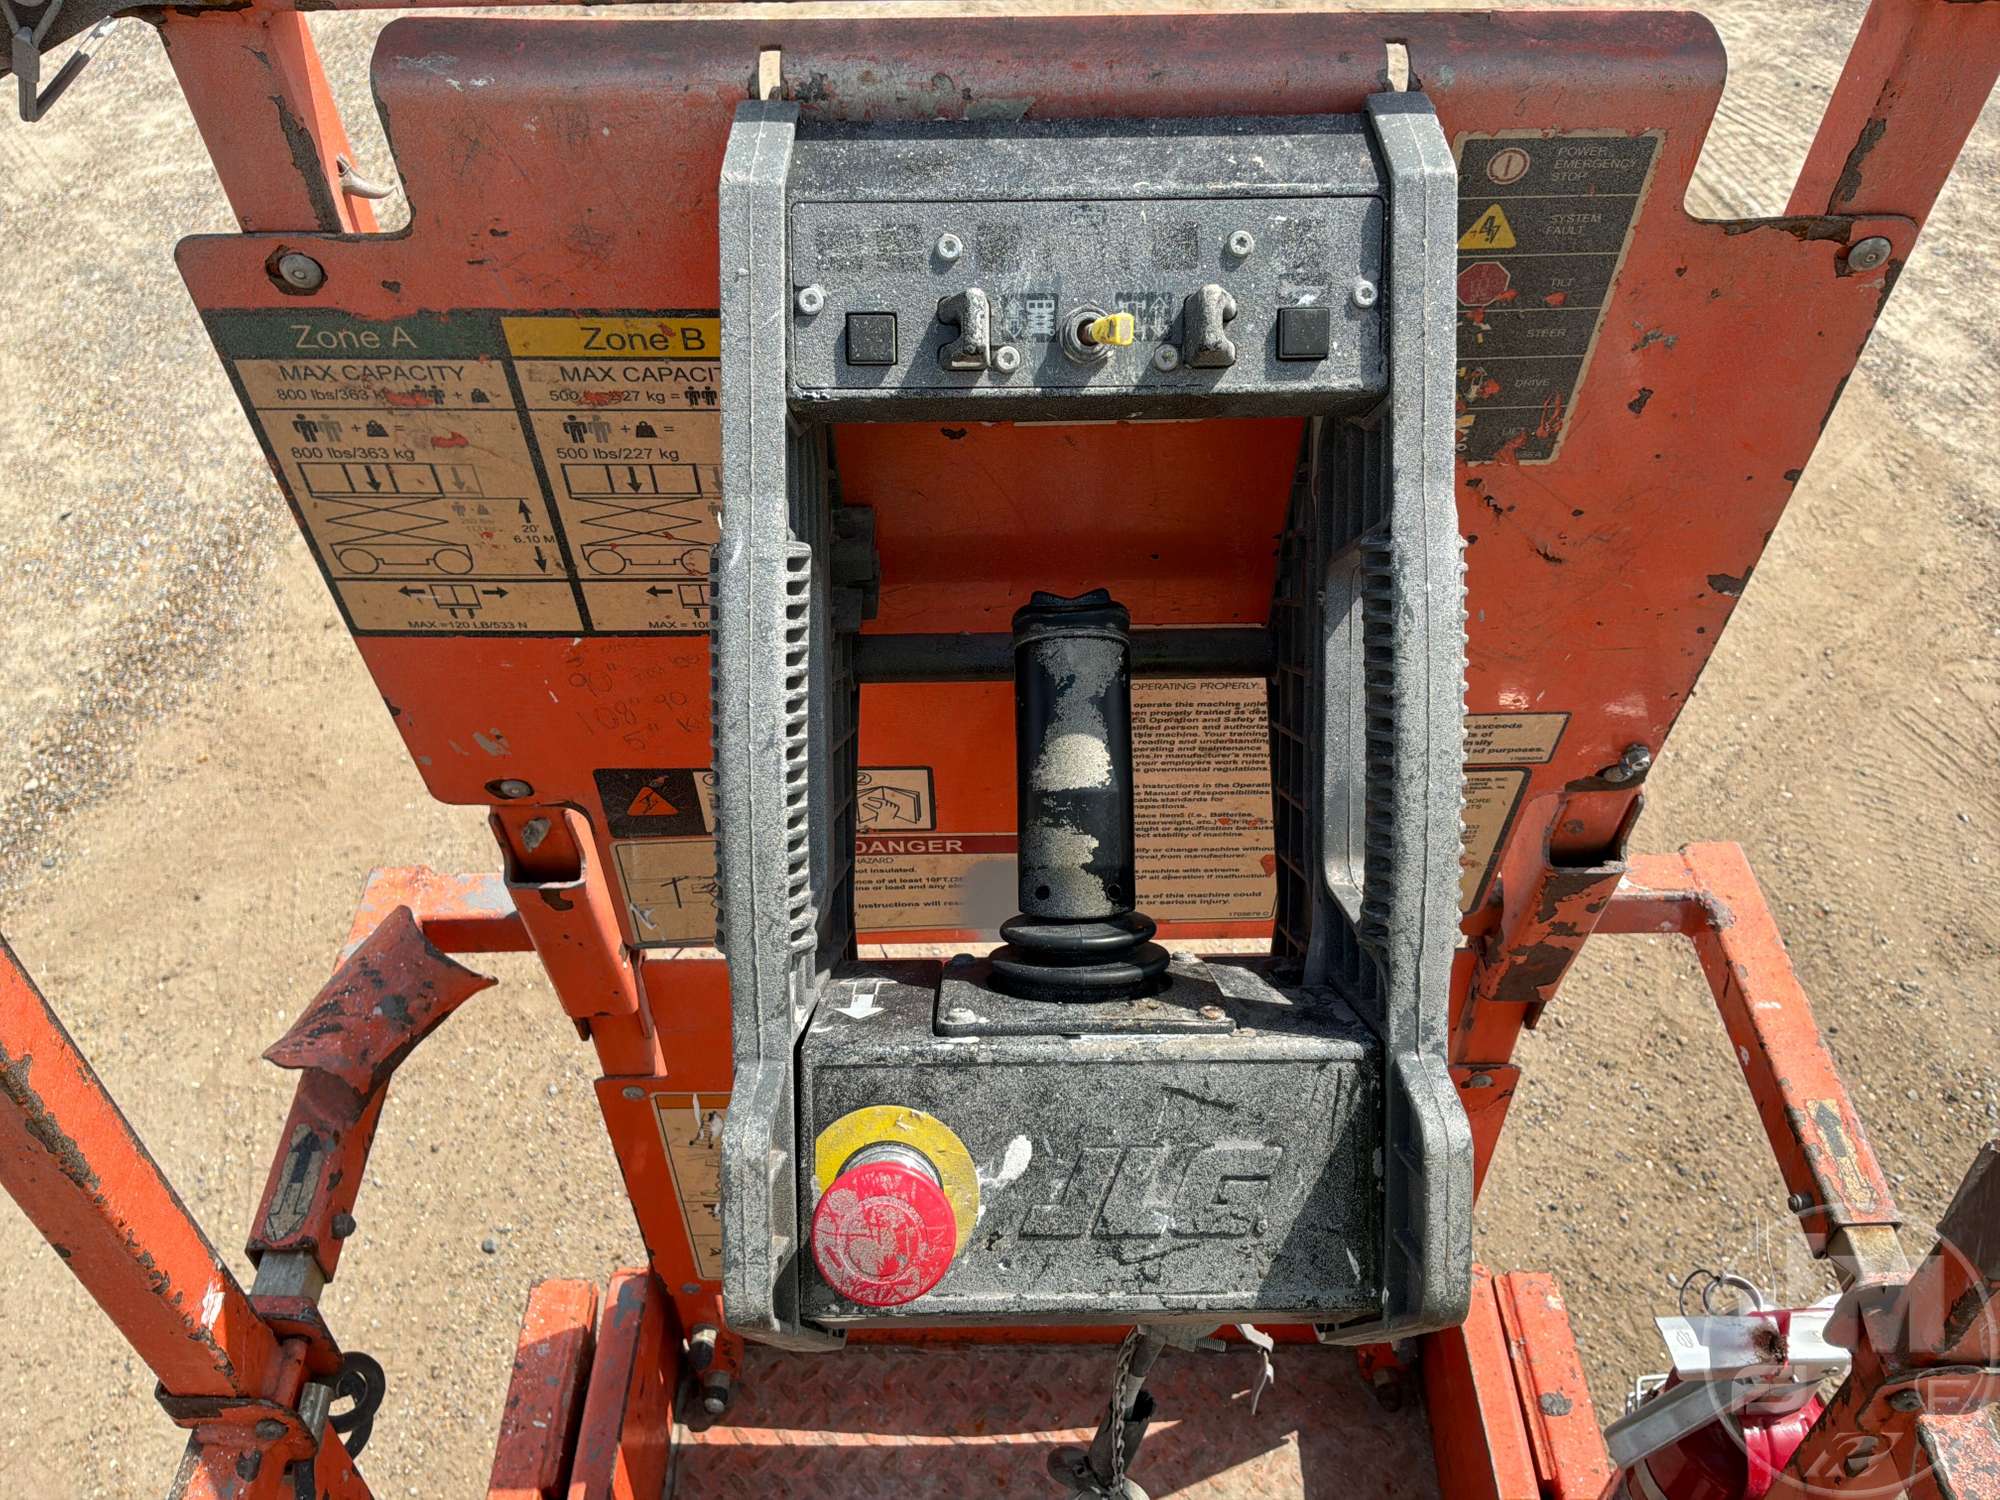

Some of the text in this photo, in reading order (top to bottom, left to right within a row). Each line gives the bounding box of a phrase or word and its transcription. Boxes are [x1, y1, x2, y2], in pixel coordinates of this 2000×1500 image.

[1558, 146, 1607, 157] POWER
[1553, 158, 1637, 169] EMERGENCY
[1551, 171, 1589, 182] STOP
[1550, 213, 1602, 224] SYSTEM
[1545, 225, 1585, 236] FAULT
[289, 324, 417, 349] Zone A
[580, 327, 706, 351] Zone B
[1526, 329, 1567, 338] STEER
[279, 364, 464, 382] MAX CAPACITY
[559, 366, 616, 382] MAX
[1514, 378, 1550, 388] DRIVE
[277, 388, 307, 401] 800
[310, 388, 367, 401] lbs/363
[550, 390, 579, 401] 500
[646, 390, 666, 405] kg
[291, 447, 415, 461] 800 lbs/363 kg
[556, 447, 680, 462] 500 lbs/227 kg
[513, 535, 555, 543] 6.10 M
[407, 620, 437, 629] MAX
[518, 620, 528, 629] N
[1131, 682, 1197, 690] OPERATING
[1134, 701, 1172, 709] operate
[1150, 710, 1192, 718] properly
[1149, 717, 1199, 725] Operation
[1223, 716, 1256, 724] Safety
[1134, 731, 1152, 739] this
[1229, 731, 1268, 739] training
[1143, 766, 1209, 774] governmental
[1193, 789, 1270, 797] Responsibilities
[1174, 825, 1233, 833] specification
[856, 840, 963, 854] DANGER
[1161, 874, 1205, 882] operation
[858, 901, 920, 909] instructions
[1019, 1144, 1282, 1238] JLG
